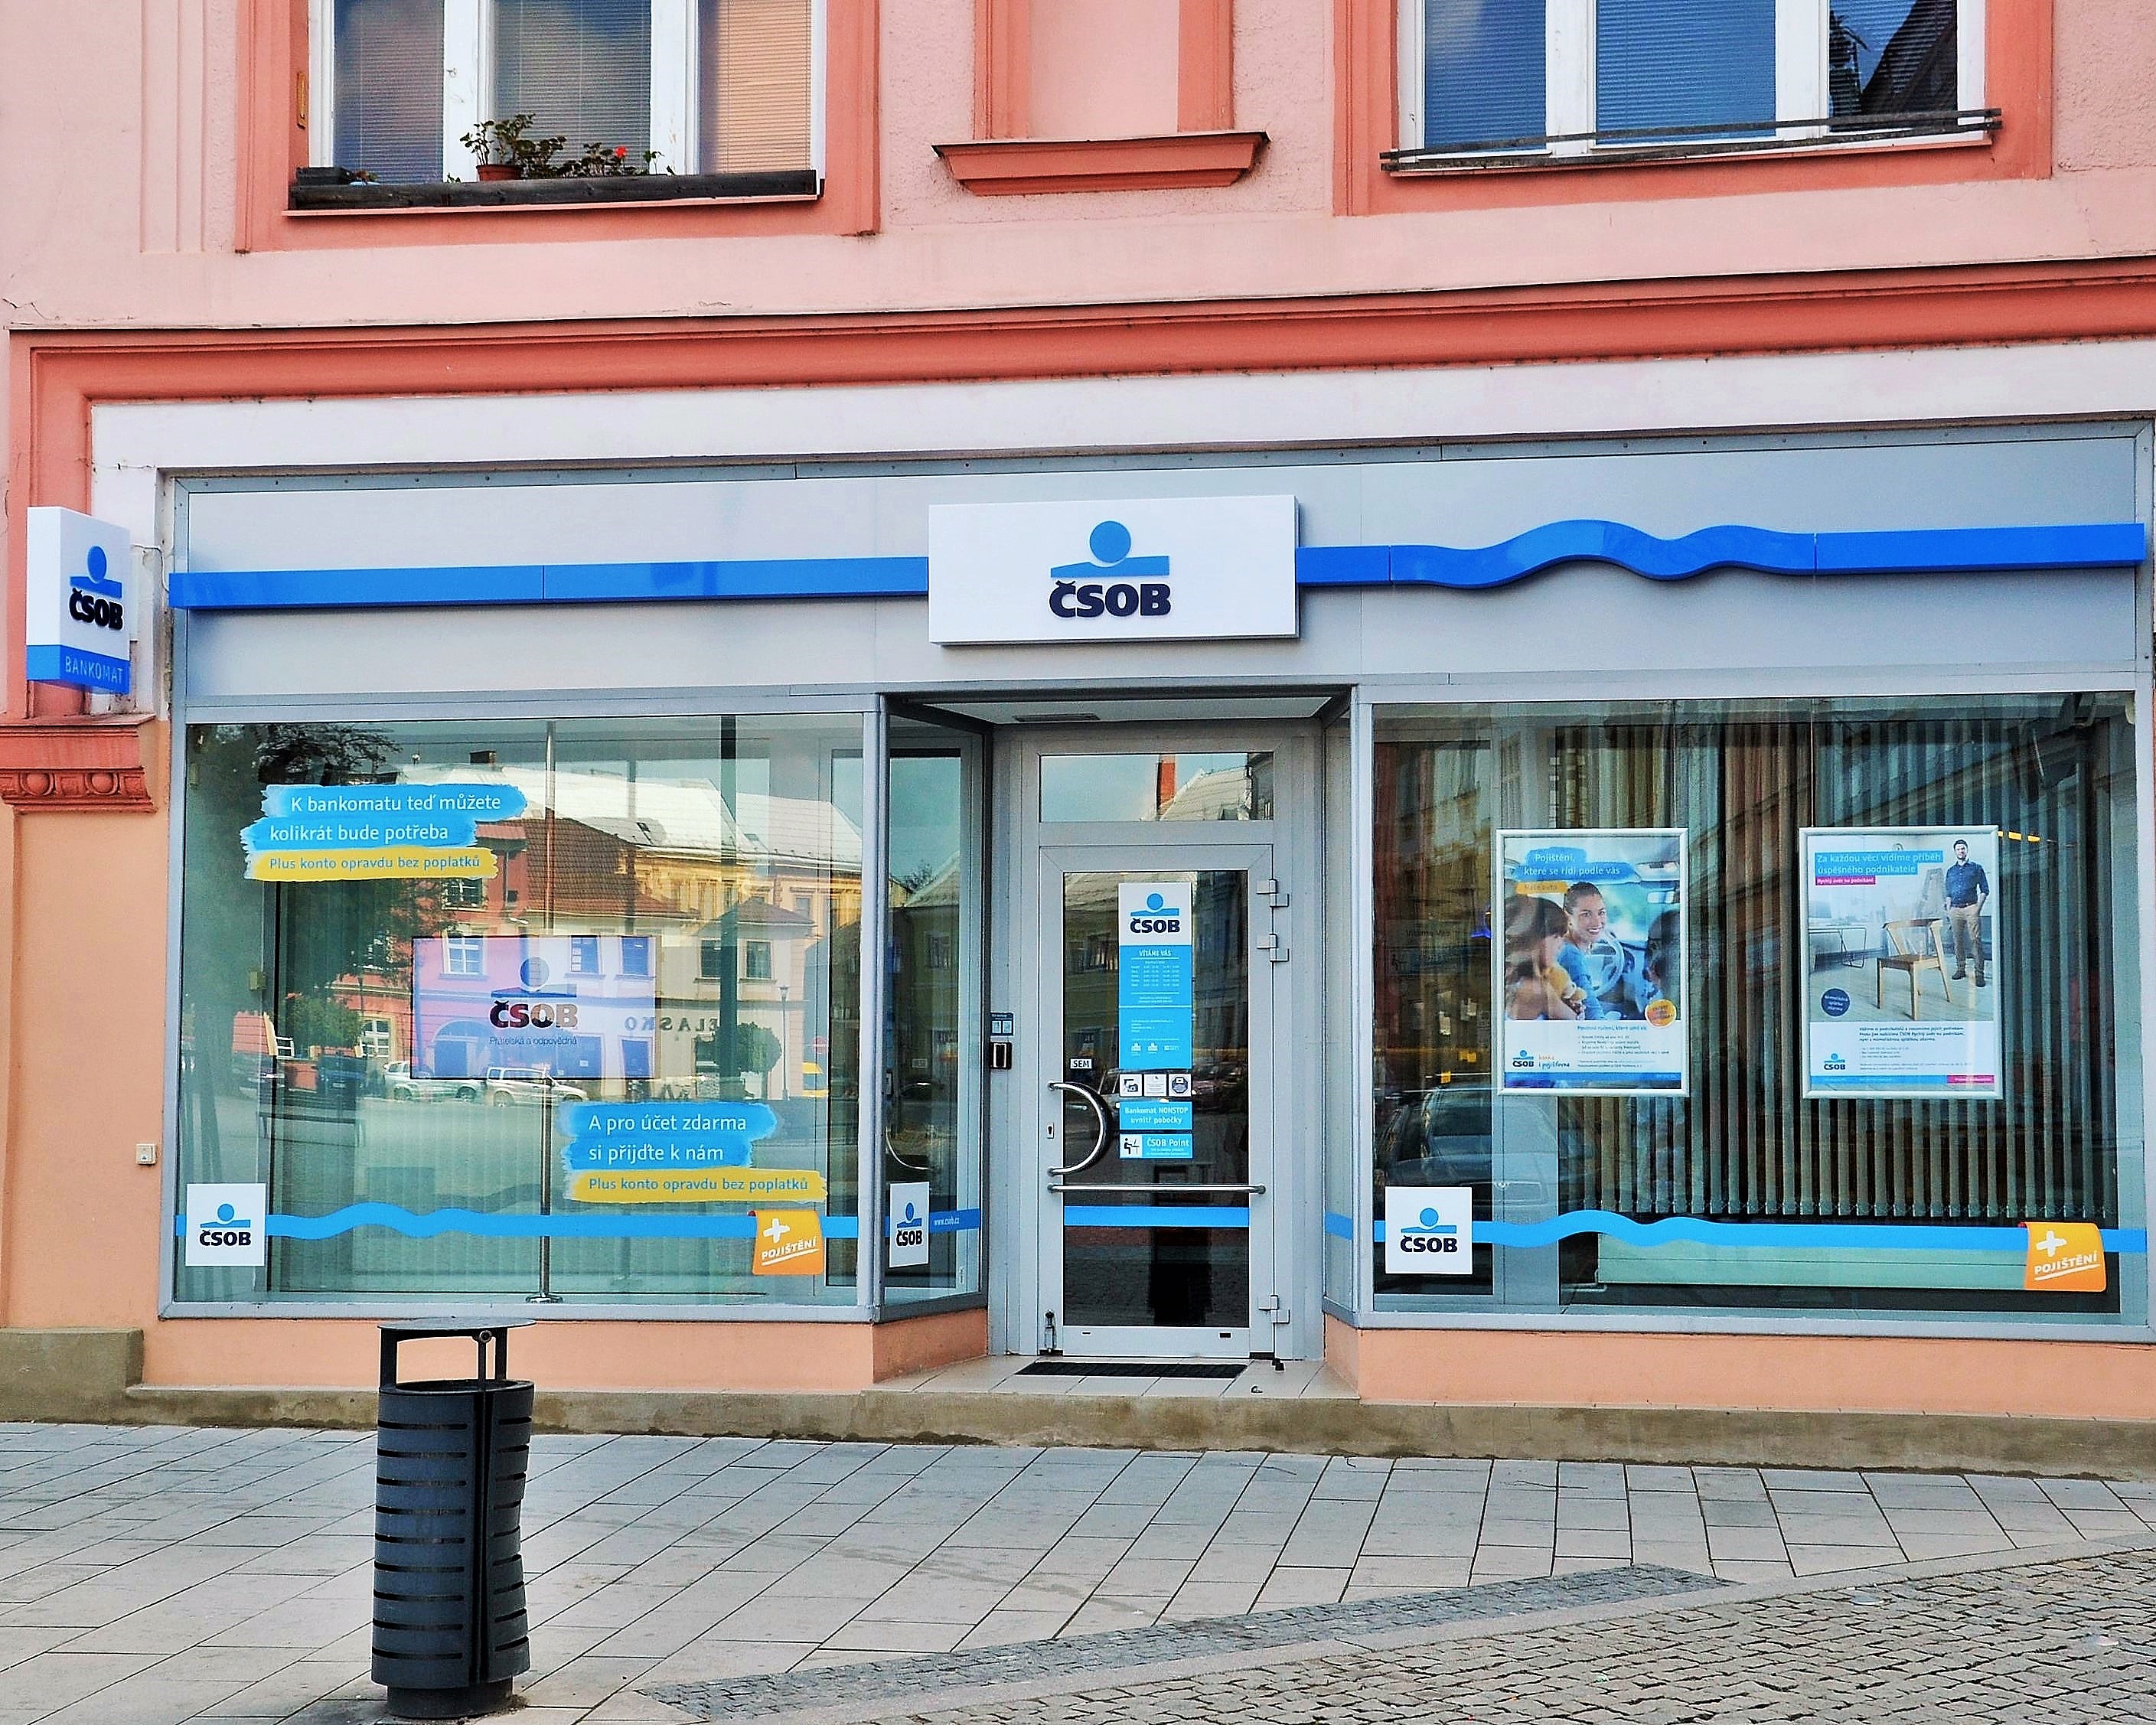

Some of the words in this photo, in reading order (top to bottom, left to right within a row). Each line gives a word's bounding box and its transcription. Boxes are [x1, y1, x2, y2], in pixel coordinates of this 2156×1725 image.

[1049, 580, 1171, 618] ČSOB
[69, 588, 122, 631] ČSOB
[65, 656, 122, 683] BANKOMAT
[292, 797, 302, 811] K
[308, 796, 400, 811] bankomatu
[407, 794, 436, 810] teď
[440, 794, 501, 810] můžete
[269, 826, 333, 840] kolikrát
[338, 825, 379, 840] bude
[385, 823, 448, 844] potřeba
[270, 858, 295, 869] Plus
[301, 857, 337, 869] konto
[341, 857, 393, 870] opravdu
[398, 856, 419, 867] bez
[424, 855, 480, 871] poplatků
[1818, 854, 1828, 862] Za
[1831, 853, 1859, 862] každou
[1579, 866, 1603, 876] podle
[1866, 864, 1916, 875] podnikatele
[1130, 918, 1180, 933] ČSOB
[490, 1000, 578, 1028] ČSOB
[589, 1115, 602, 1130] A
[607, 1118, 635, 1135] pro
[641, 1114, 677, 1131] účet
[683, 1114, 747, 1131] zdarma
[1153, 1116, 1182, 1124] pobočky
[1146, 1137, 1166, 1146] ČSOB
[1169, 1138, 1190, 1147] Point
[589, 1146, 602, 1160] si
[608, 1144, 664, 1165] přijďte
[670, 1145, 680, 1160] k
[686, 1143, 723, 1160] nám
[589, 1179, 616, 1189] Plus
[621, 1179, 658, 1189] konto
[664, 1179, 717, 1192] opravdu
[722, 1178, 744, 1189] bez
[749, 1176, 808, 1192] poplatků
[200, 1229, 251, 1247] ČSOB
[896, 1229, 922, 1247] ČSOB
[1399, 1235, 1458, 1253] ČSOB
[762, 1236, 817, 1261] POJIŠTĚNÍ
[2034, 1251, 2098, 1274] POJIŠTĚNÍ
